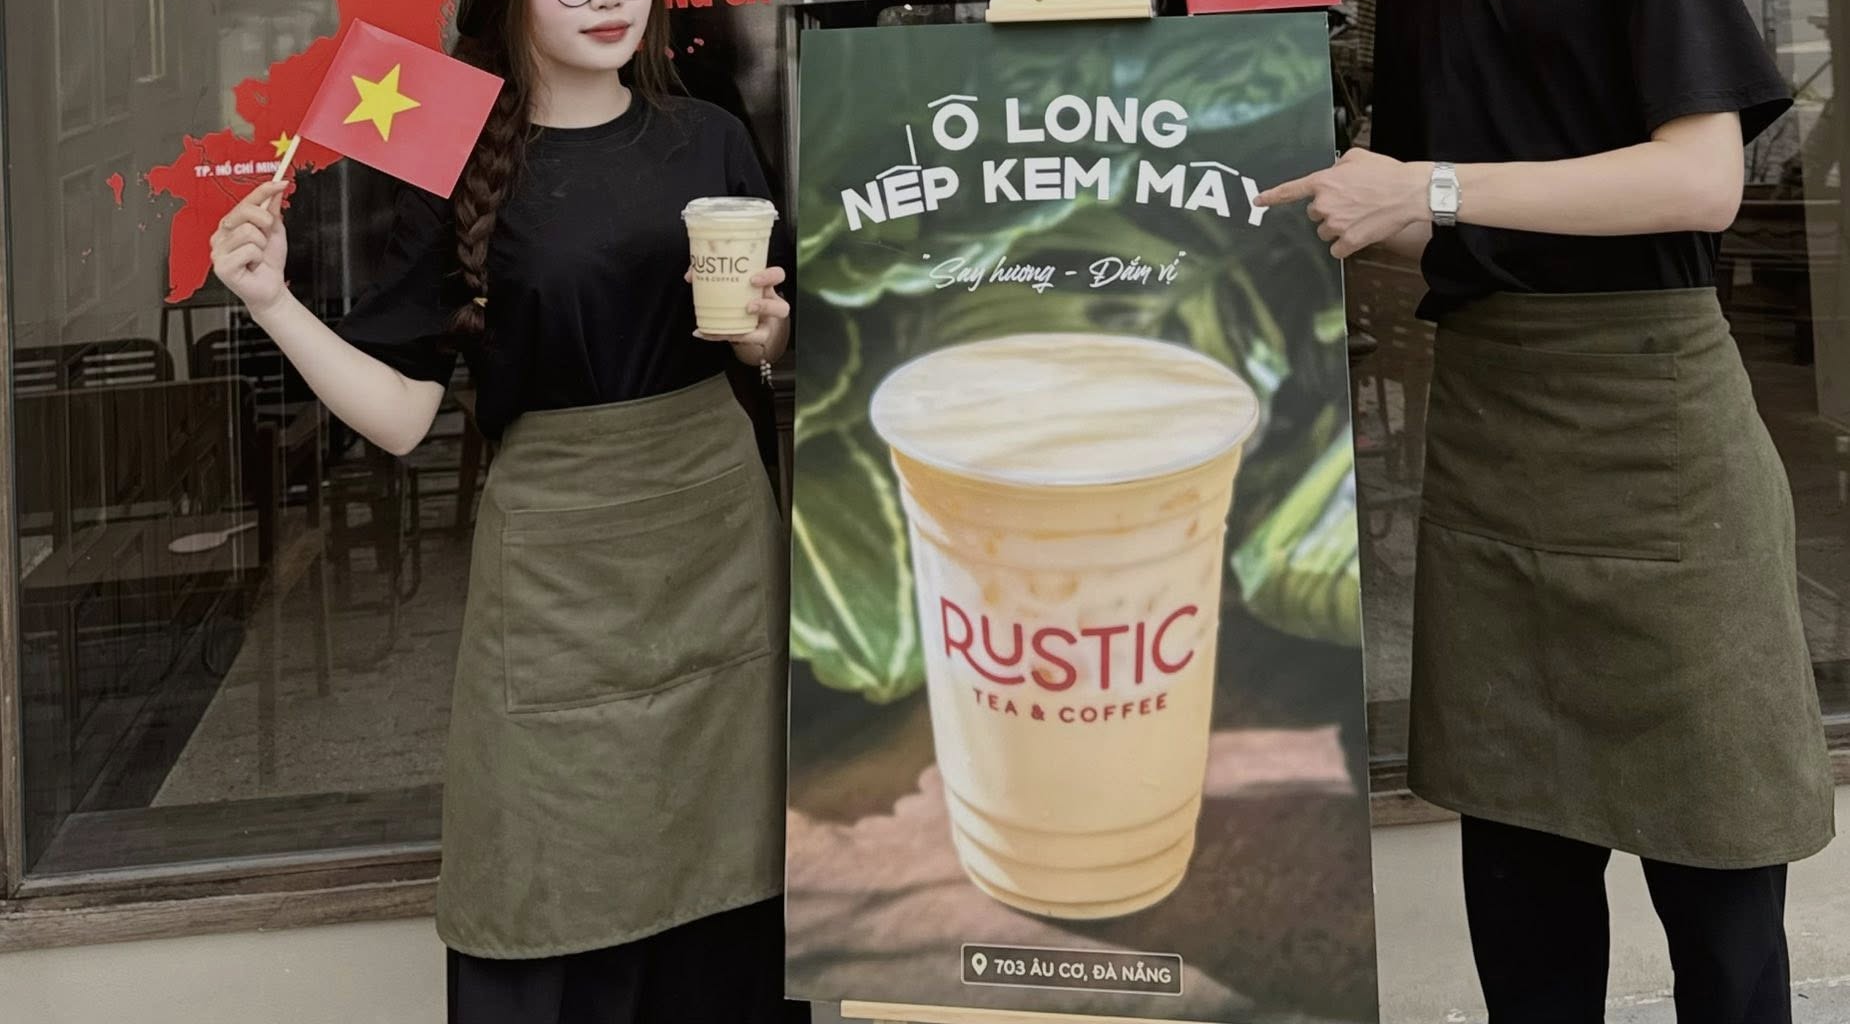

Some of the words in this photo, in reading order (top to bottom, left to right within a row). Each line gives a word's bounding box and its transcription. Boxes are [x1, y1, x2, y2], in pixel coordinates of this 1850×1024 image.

[927, 94, 979, 151] Ô
[1006, 94, 1189, 149] LONG
[840, 124, 960, 232] NẾP
[982, 156, 1110, 204] KEM
[1135, 160, 1271, 227] MÂY
[940, 596, 1198, 692] RUSTIC
[973, 688, 1018, 717] TEA
[1031, 704, 1046, 722] &
[1059, 693, 1168, 724] COFFEE
[994, 958, 1026, 976] 703
[1030, 957, 1054, 977] ÂU
[1058, 962, 1088, 982] CƠ,
[1092, 961, 1118, 981] ĐÀ
[1122, 960, 1172, 984] NẴNG
